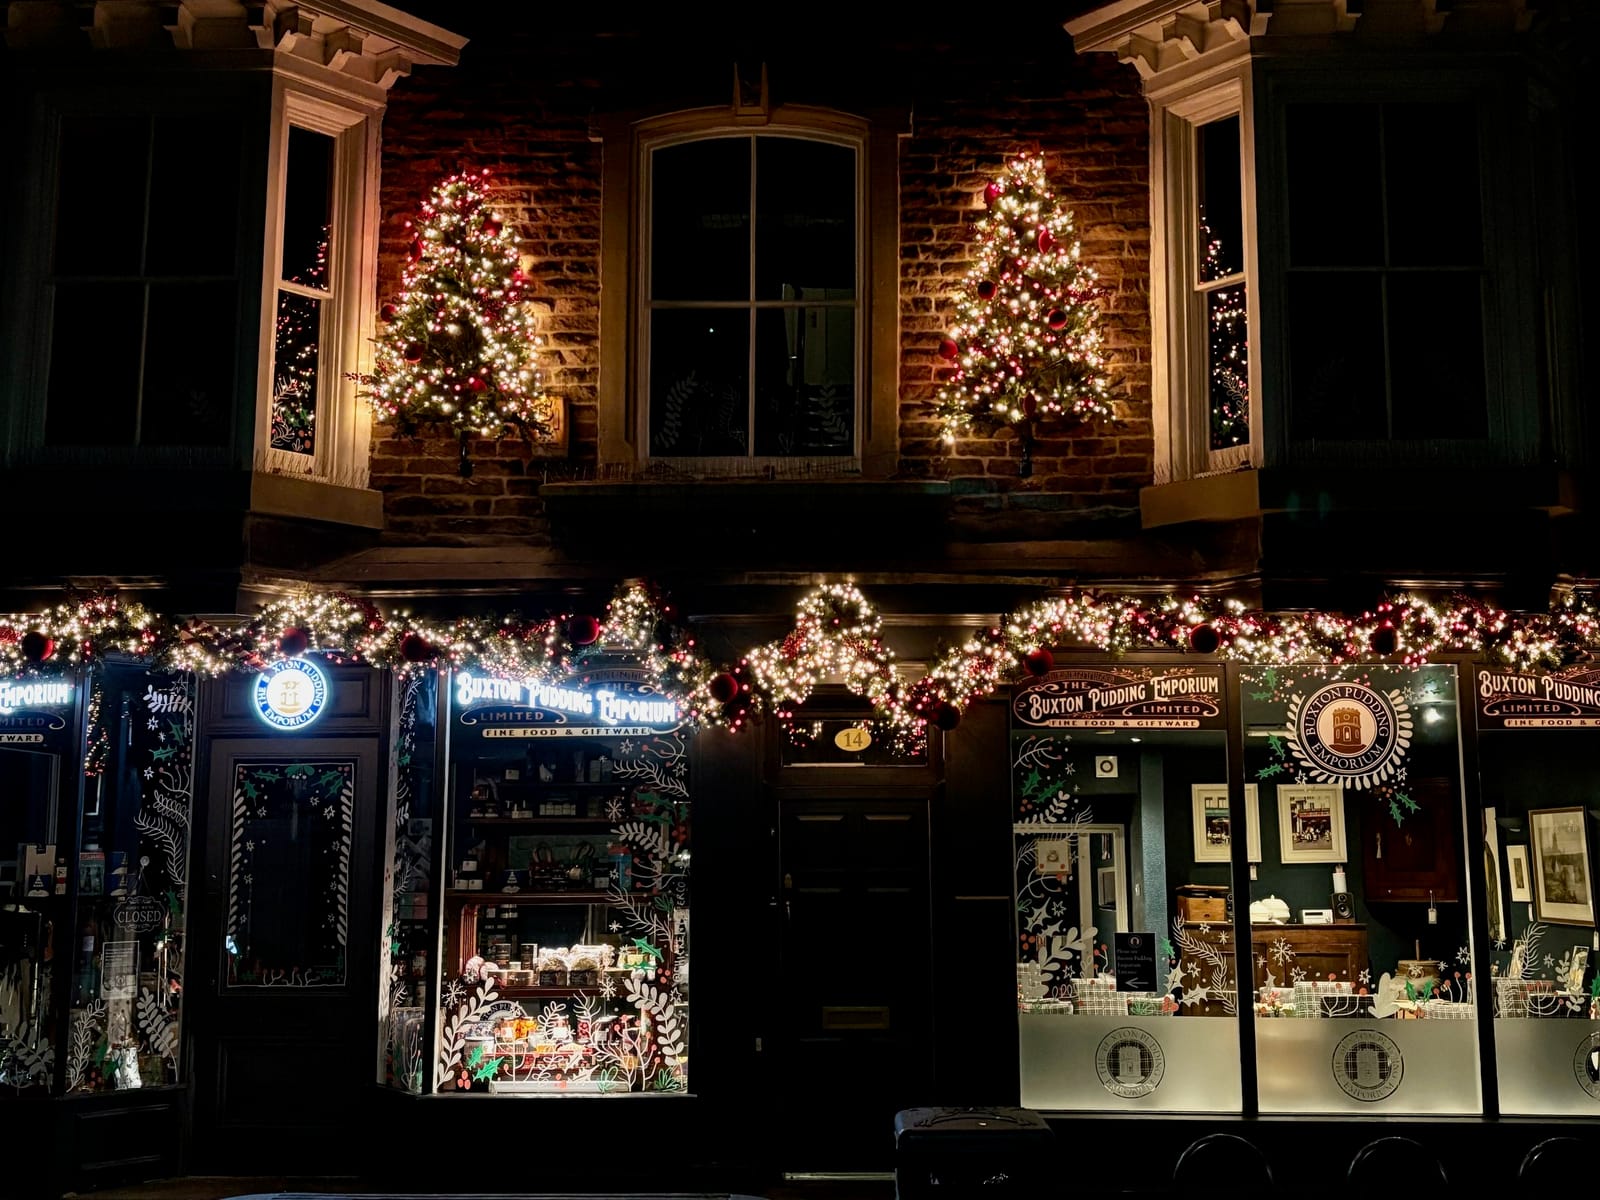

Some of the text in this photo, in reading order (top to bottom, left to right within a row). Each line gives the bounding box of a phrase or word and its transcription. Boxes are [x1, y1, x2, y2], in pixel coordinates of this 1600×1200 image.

[257, 686, 269, 706] THE
[302, 663, 325, 707] PUDDING
[604, 682, 635, 692] THE
[1062, 681, 1092, 690] THE
[1478, 670, 1537, 698] BUXTON
[457, 672, 677, 725] BUXTON PUDDING EMPORIUM
[1029, 676, 1220, 720] BUXTON PUDDING EMPORIUM
[480, 711, 544, 721] LIMITED
[1142, 705, 1201, 713] LIMITED
[1304, 687, 1390, 737] BUXTON PUDDING
[1502, 704, 1561, 713] LIMITED
[264, 708, 315, 727] EMPORIUM
[486, 727, 649, 737] FINE FOOD & GIFTWARE
[844, 732, 863, 747] 14
[1311, 743, 1384, 769] EMPORIUM
[117, 910, 162, 923] CLOSED
